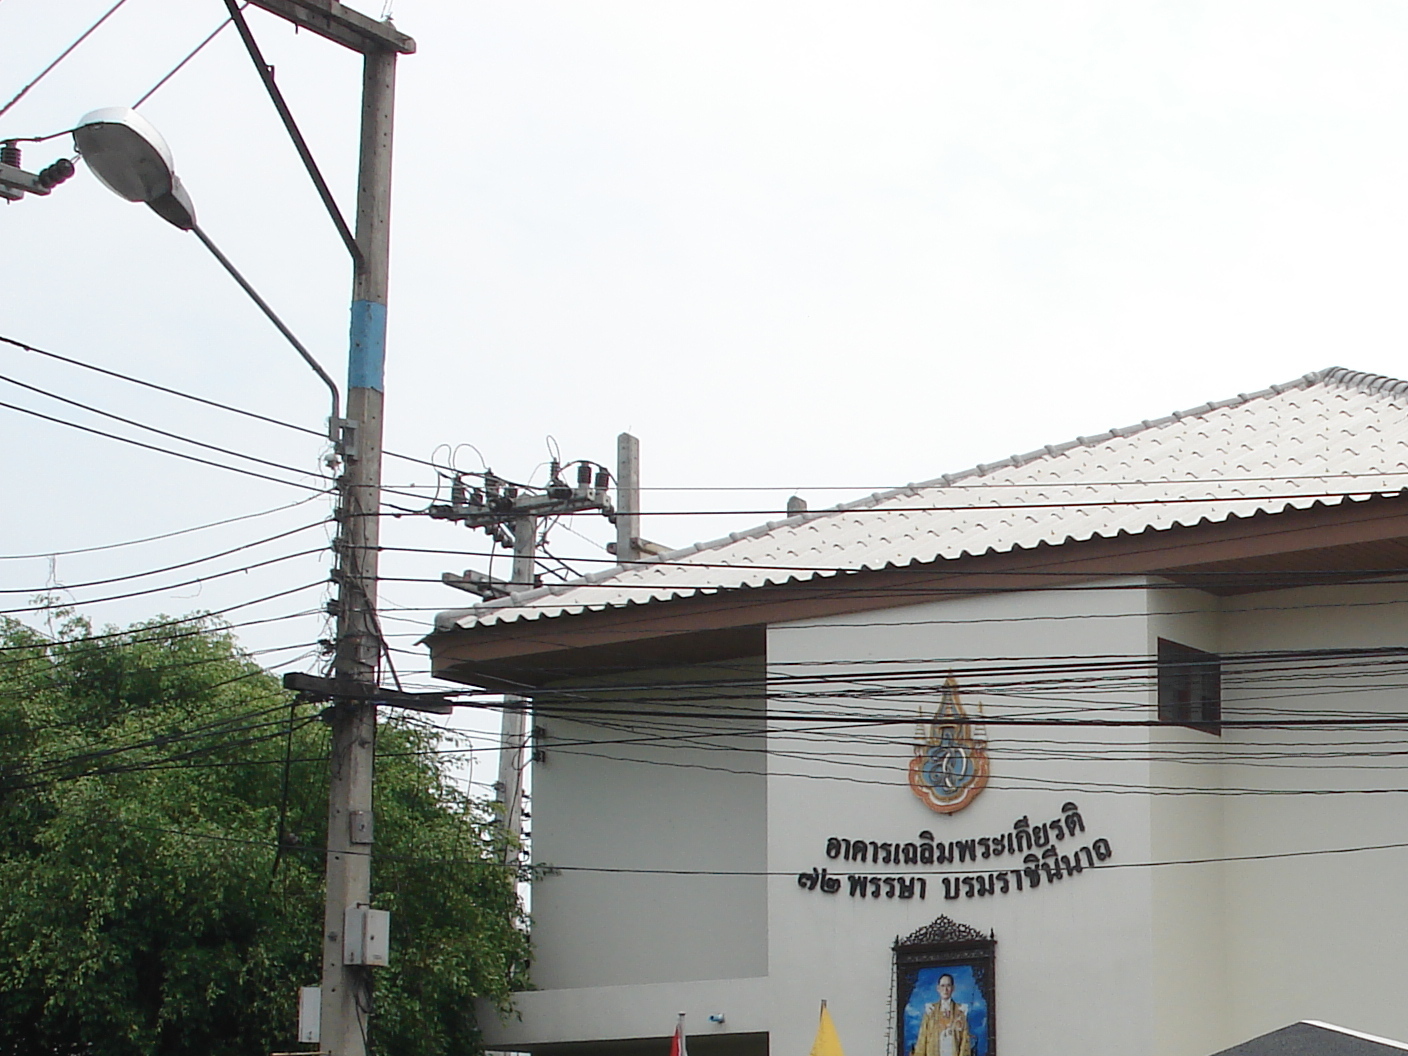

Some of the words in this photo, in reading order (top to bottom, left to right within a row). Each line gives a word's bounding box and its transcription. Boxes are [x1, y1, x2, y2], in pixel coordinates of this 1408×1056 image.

[825, 801, 1086, 866] อาคารเฉลิมพระเกียรติ
[848, 874, 927, 900] พรรษา
[942, 836, 1113, 900] บรมราชินีนาถ
